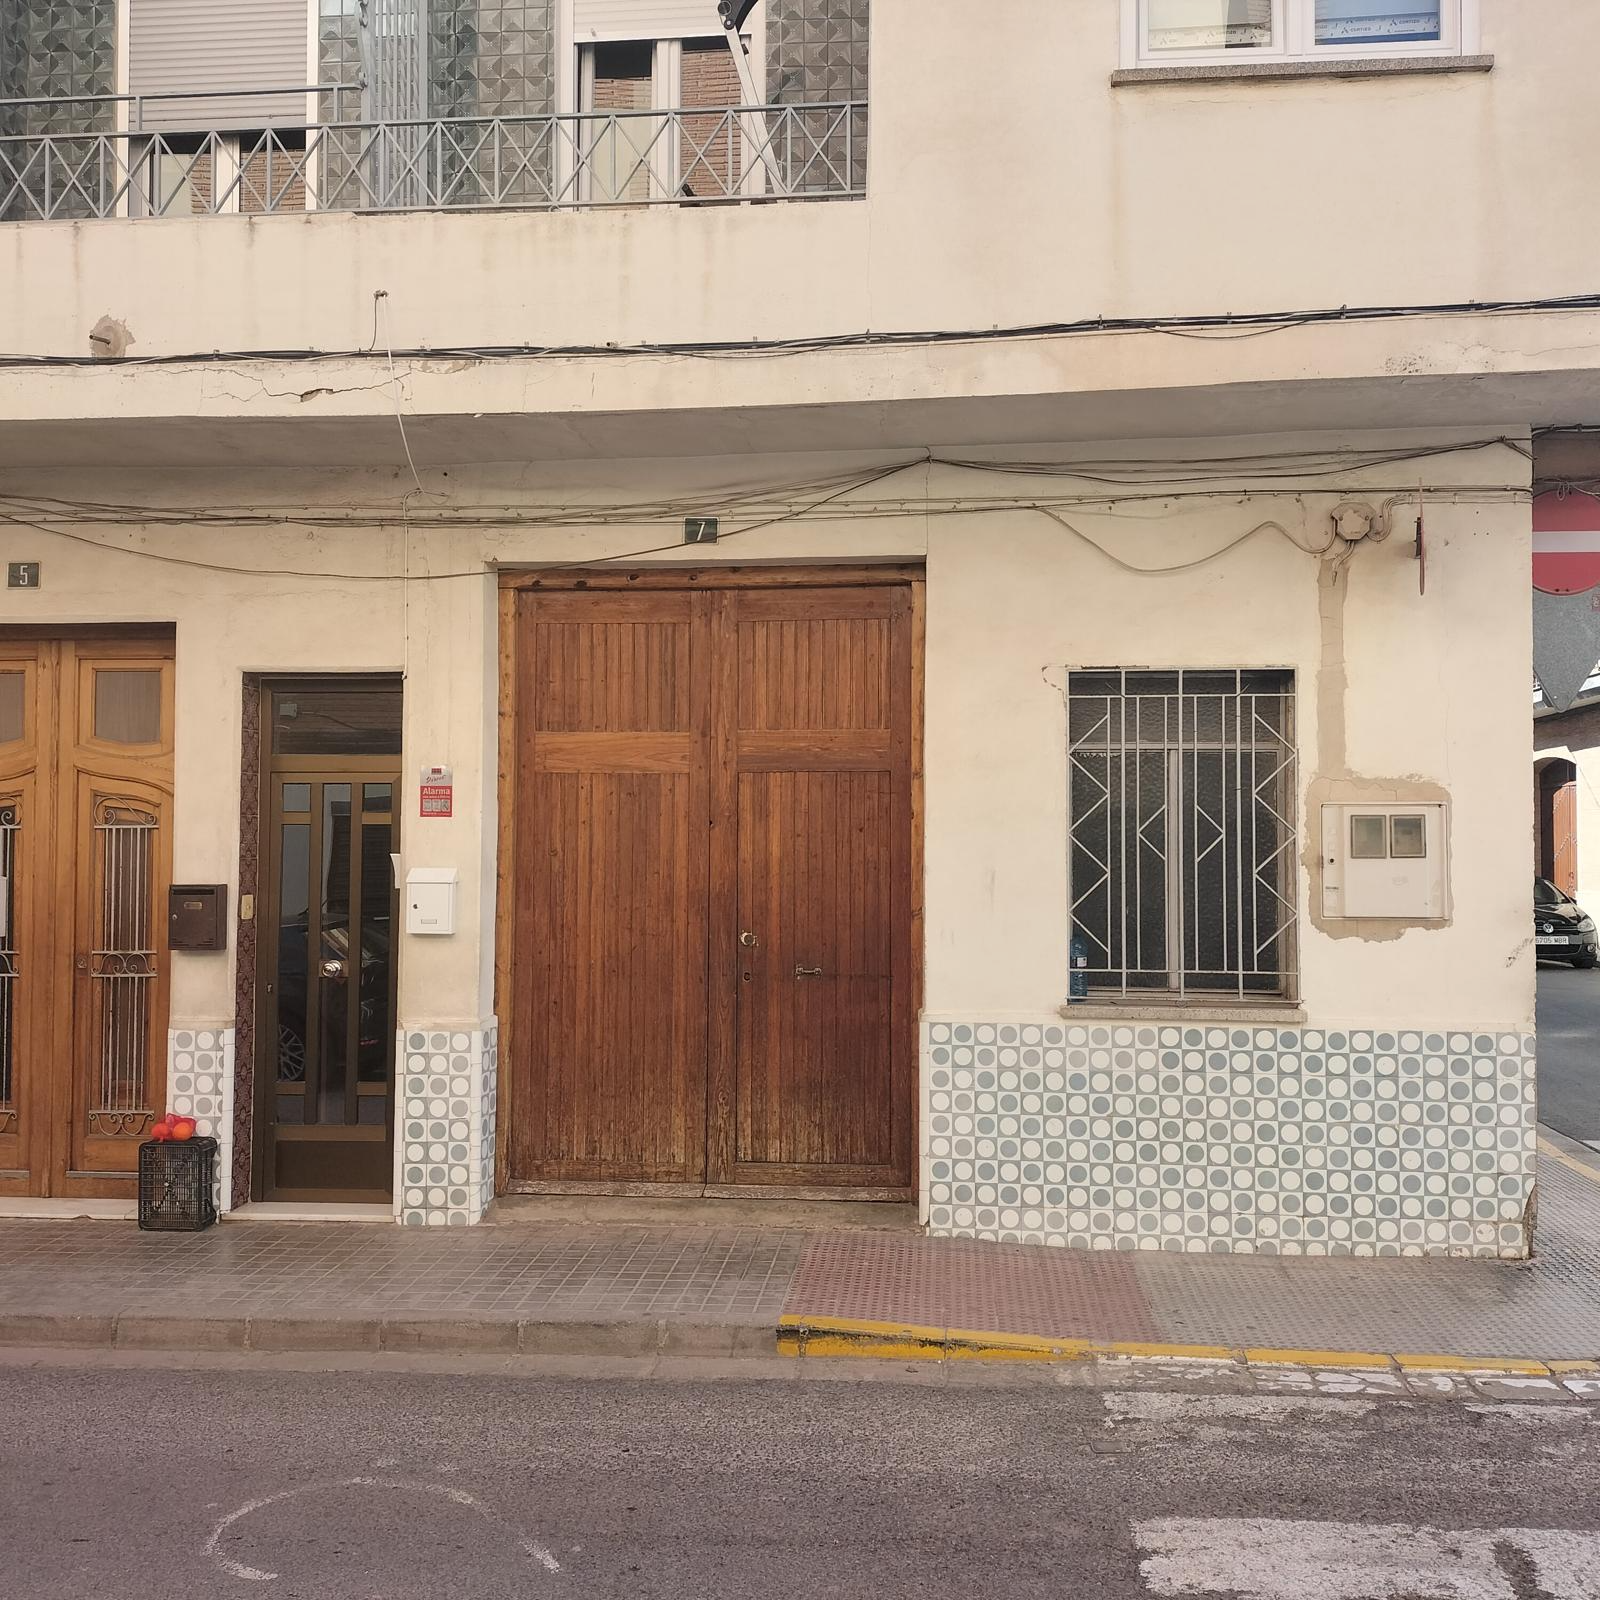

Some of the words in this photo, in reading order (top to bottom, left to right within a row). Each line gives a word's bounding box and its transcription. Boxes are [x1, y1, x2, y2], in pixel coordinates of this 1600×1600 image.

[697, 521, 706, 541] 7
[19, 565, 28, 585] 5
[422, 786, 450, 795] Alarma
